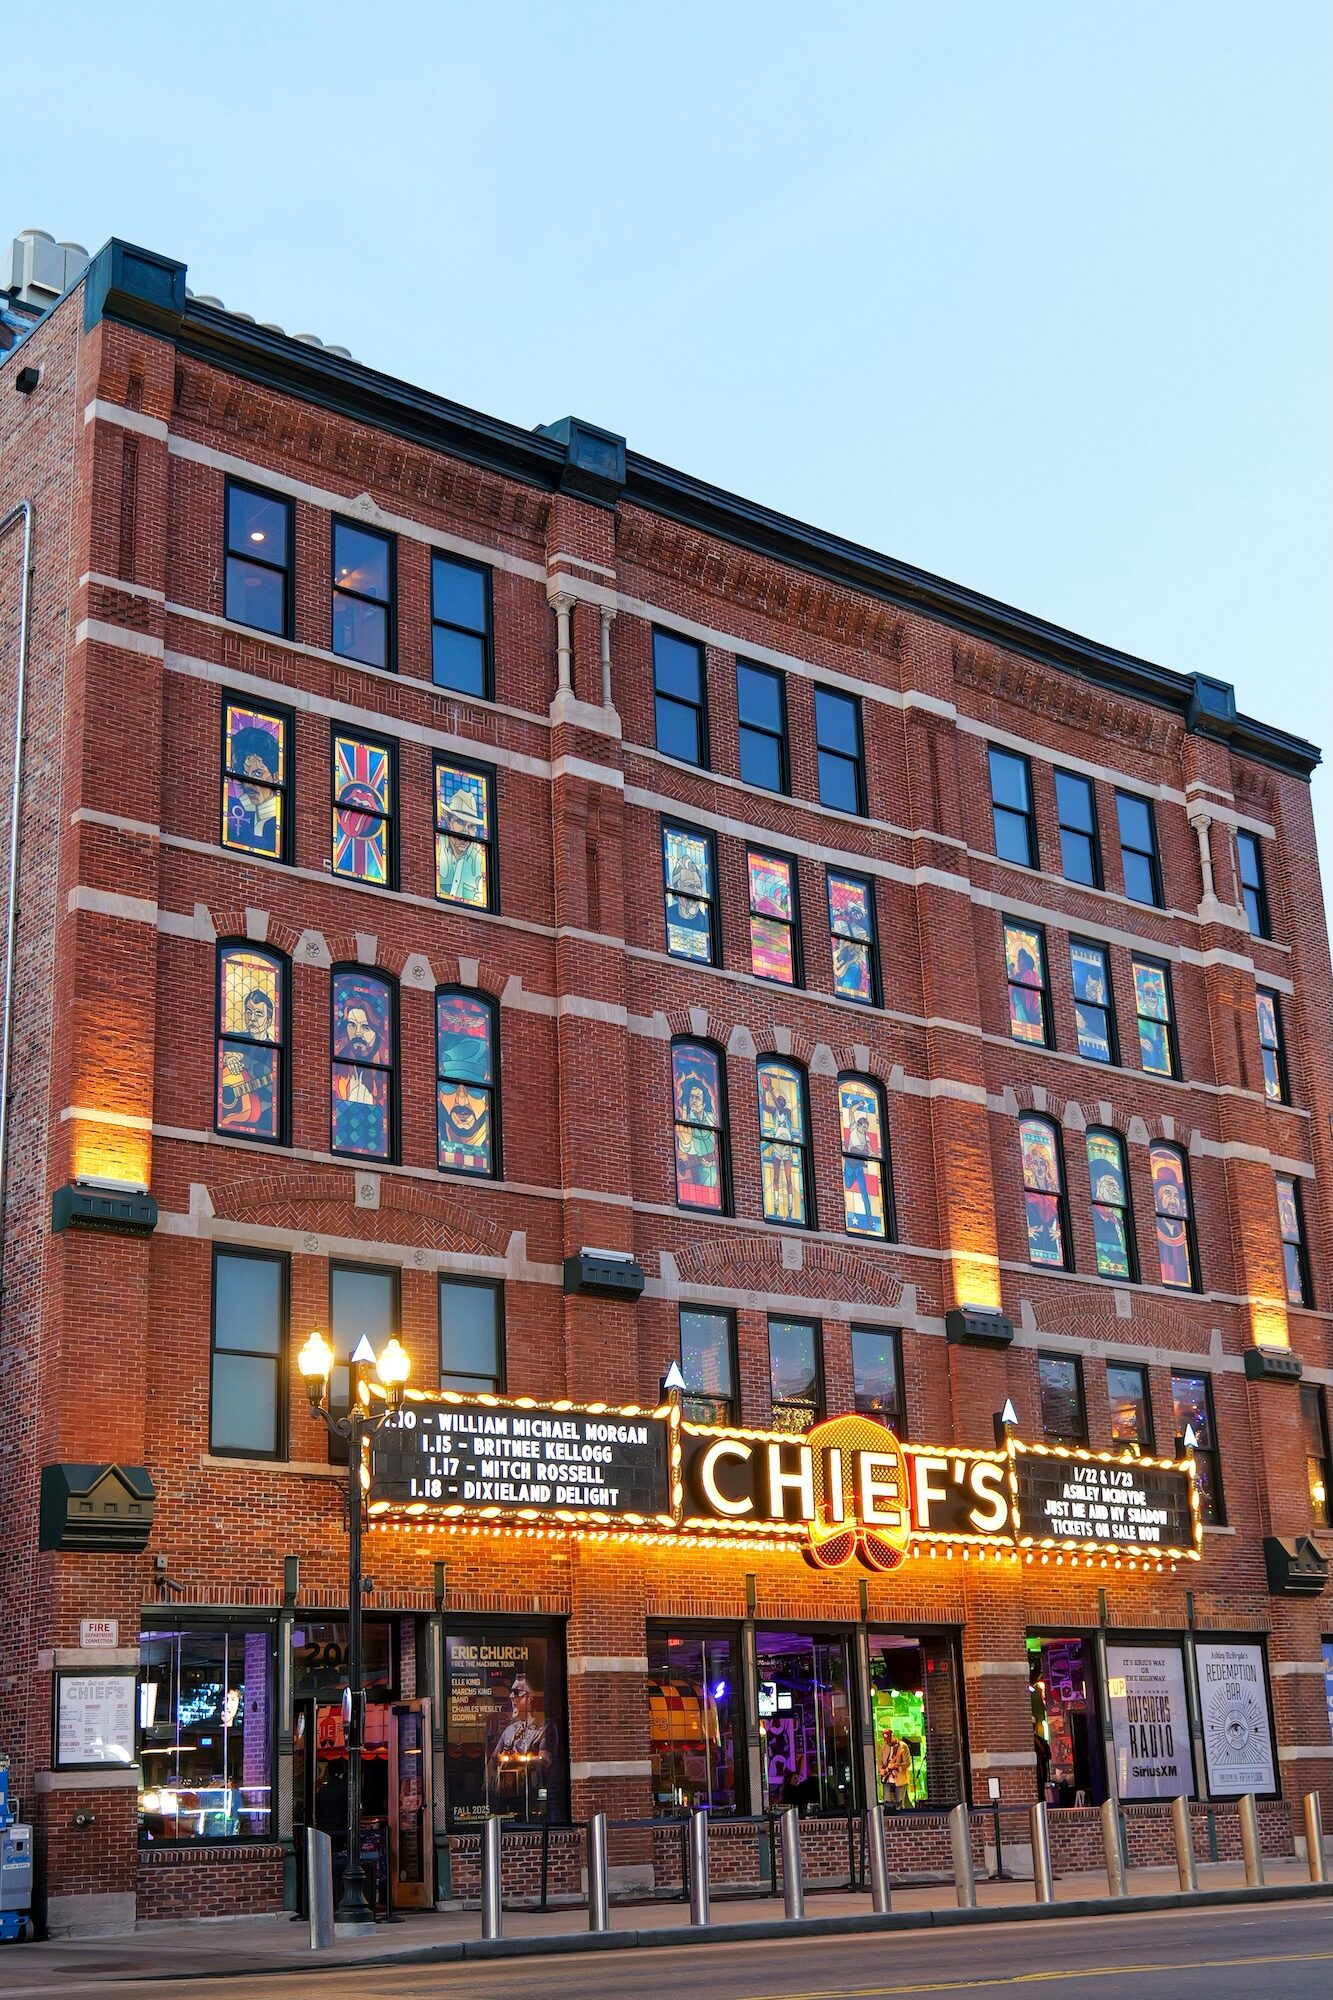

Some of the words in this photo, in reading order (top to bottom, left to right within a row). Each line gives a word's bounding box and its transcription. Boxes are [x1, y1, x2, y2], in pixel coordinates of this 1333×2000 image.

[438, 1413, 508, 1437] WILLIAM
[512, 1418, 581, 1441] MICHAEL
[585, 1423, 648, 1445] MORGAN
[422, 1434, 452, 1453] 1.15
[473, 1437, 540, 1460] BRITNEE
[545, 1442, 613, 1464] KELLOGG
[430, 1456, 460, 1476] 1.17
[481, 1459, 531, 1481] MITCH
[536, 1462, 605, 1485] ROSSELL
[1073, 1466, 1098, 1485] 1/22
[1110, 1470, 1134, 1488] 1/23
[410, 1478, 442, 1498] 1.18
[463, 1479, 551, 1503] DIXIELAND
[555, 1484, 619, 1507] DELIGHT
[702, 1439, 1009, 1532] CHIEF'S
[1062, 1483, 1100, 1503] ASHLEY
[1044, 1500, 1070, 1518] JUST
[1072, 1503, 1087, 1519] ME
[1089, 1505, 1109, 1521] AND
[1110, 1507, 1126, 1523] MY
[1127, 1508, 1168, 1526] SHADOW
[1051, 1518, 1093, 1538] TICKETS
[1095, 1521, 1110, 1538] ON
[1112, 1523, 1137, 1541] SALE
[1138, 1526, 1160, 1542] NOW
[89, 1623, 110, 1632] FIRE
[451, 1645, 478, 1660] ERIC
[480, 1645, 529, 1661] CHURCH
[451, 1660, 465, 1668] FREE
[465, 1660, 475, 1668] THE
[476, 1660, 500, 1668] MACHINE
[500, 1660, 515, 1668] TOUR
[1205, 1663, 1257, 1682] REDEMPTION
[451, 1678, 466, 1686] ELLE
[466, 1678, 481, 1686] KING
[451, 1687, 477, 1696] MARCUS
[477, 1687, 492, 1696] KING
[1225, 1682, 1242, 1701] BAR
[66, 1685, 125, 1700] CHIEF'S
[451, 1696, 469, 1704] BAND
[451, 1705, 479, 1713] CHARLES
[479, 1705, 503, 1713] WESLEY
[452, 1713, 477, 1721] GODWIN
[1126, 1695, 1171, 1723] OUTSIDERS
[1128, 1724, 1175, 1759] RADIO
[1132, 1765, 1177, 1778] SiriusXM
[453, 1806, 471, 1816] FALL
[472, 1805, 490, 1814] 2025
